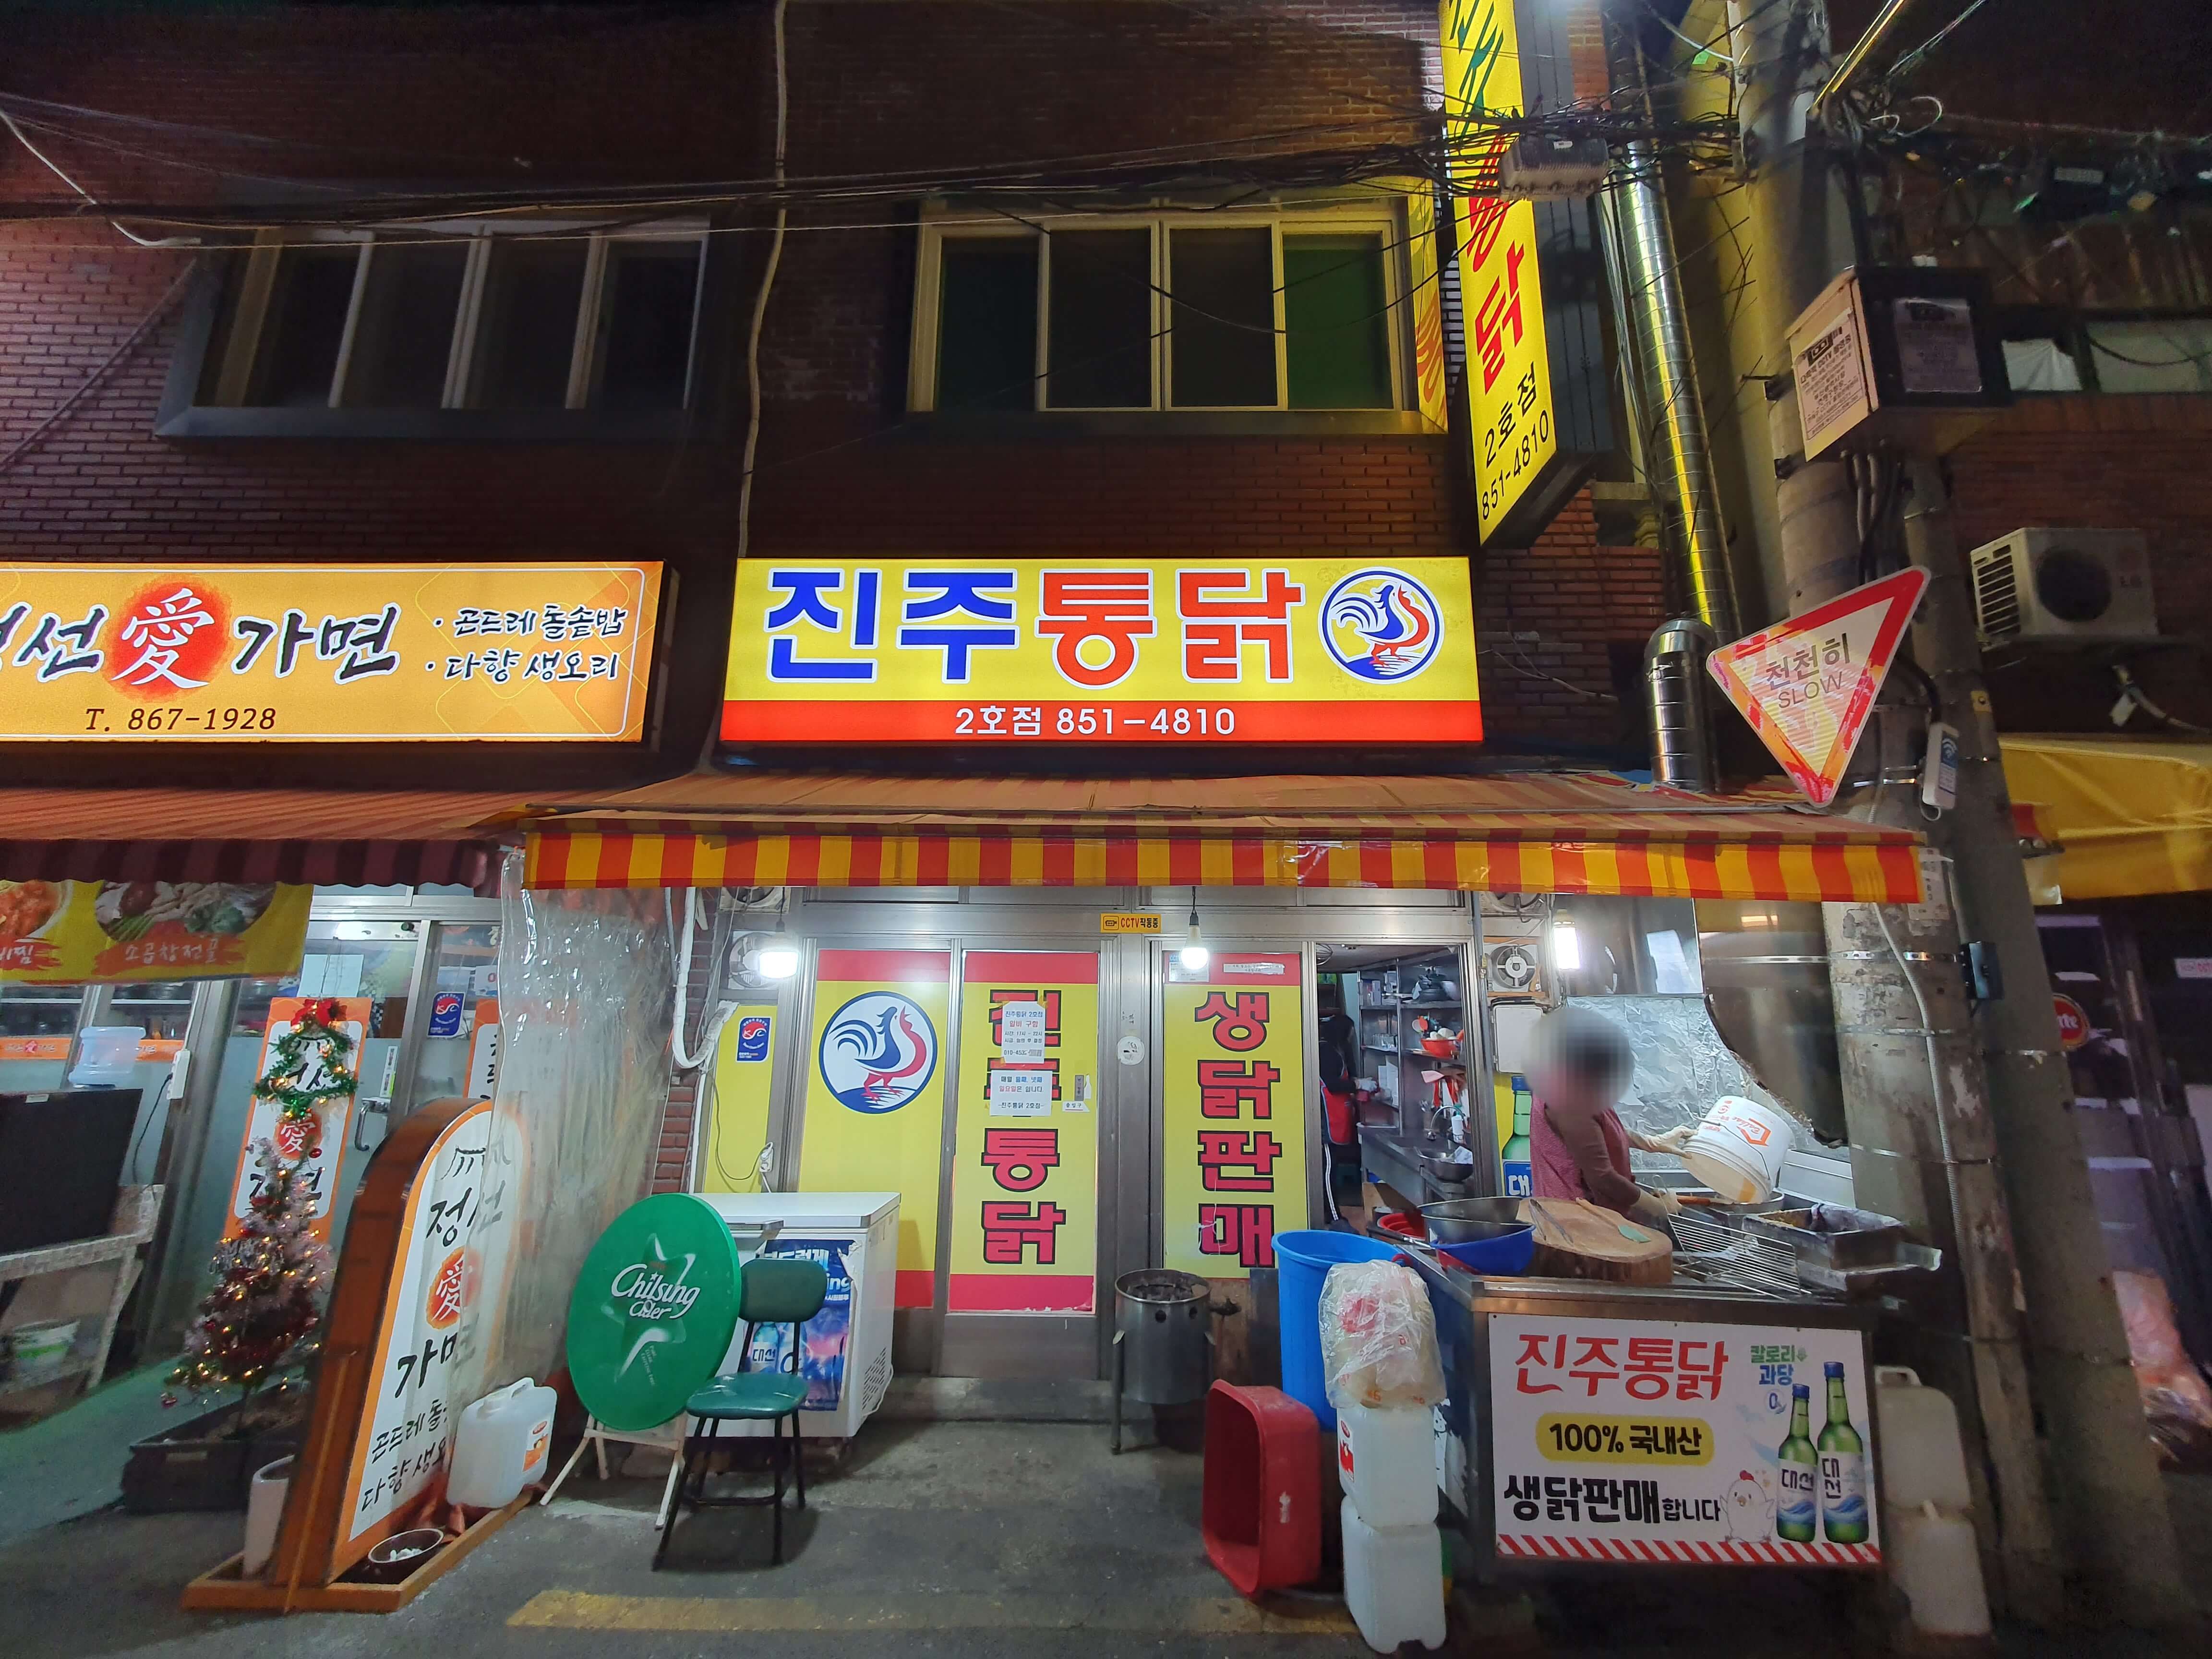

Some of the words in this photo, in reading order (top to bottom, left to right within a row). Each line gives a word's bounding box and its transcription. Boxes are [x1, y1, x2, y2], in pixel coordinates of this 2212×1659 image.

[1486, 361, 1536, 469] 2호점
[1482, 410, 1549, 520] 851-4810
[111, 588, 215, 689] 愛
[236, 606, 400, 683] 가면
[452, 609, 533, 636] 곤드레
[539, 605, 627, 641] 돌솥밥
[766, 569, 1303, 687] 진주통닭
[445, 649, 517, 682] 다향
[526, 650, 619, 682] 생오리
[1766, 632, 1851, 690] 천천히
[1778, 671, 1843, 709] SLOW
[86, 707, 112, 733] T.
[128, 706, 276, 732] 867-1928
[956, 706, 1044, 736] 2호점
[1056, 706, 1237, 736] 851-4810
[1120, 917, 1159, 928] CCTV작동중
[1194, 991, 1282, 1268] 생닭판매
[611, 1263, 701, 1319] Chilsung
[629, 1299, 672, 1320] Cider
[1515, 1334, 1729, 1401] 진주통닭
[1750, 1344, 1795, 1363] 칼로리
[1758, 1364, 1794, 1386] 과당
[372, 1412, 426, 1464] 곤드레
[1549, 1422, 1624, 1453] 100%
[1629, 1424, 1703, 1456] 국내산
[361, 1458, 412, 1512] 다향
[1781, 1468, 1814, 1491] 대선
[1821, 1457, 1841, 1499] 대선
[1503, 1474, 1721, 1525] 생닭판매합니다
